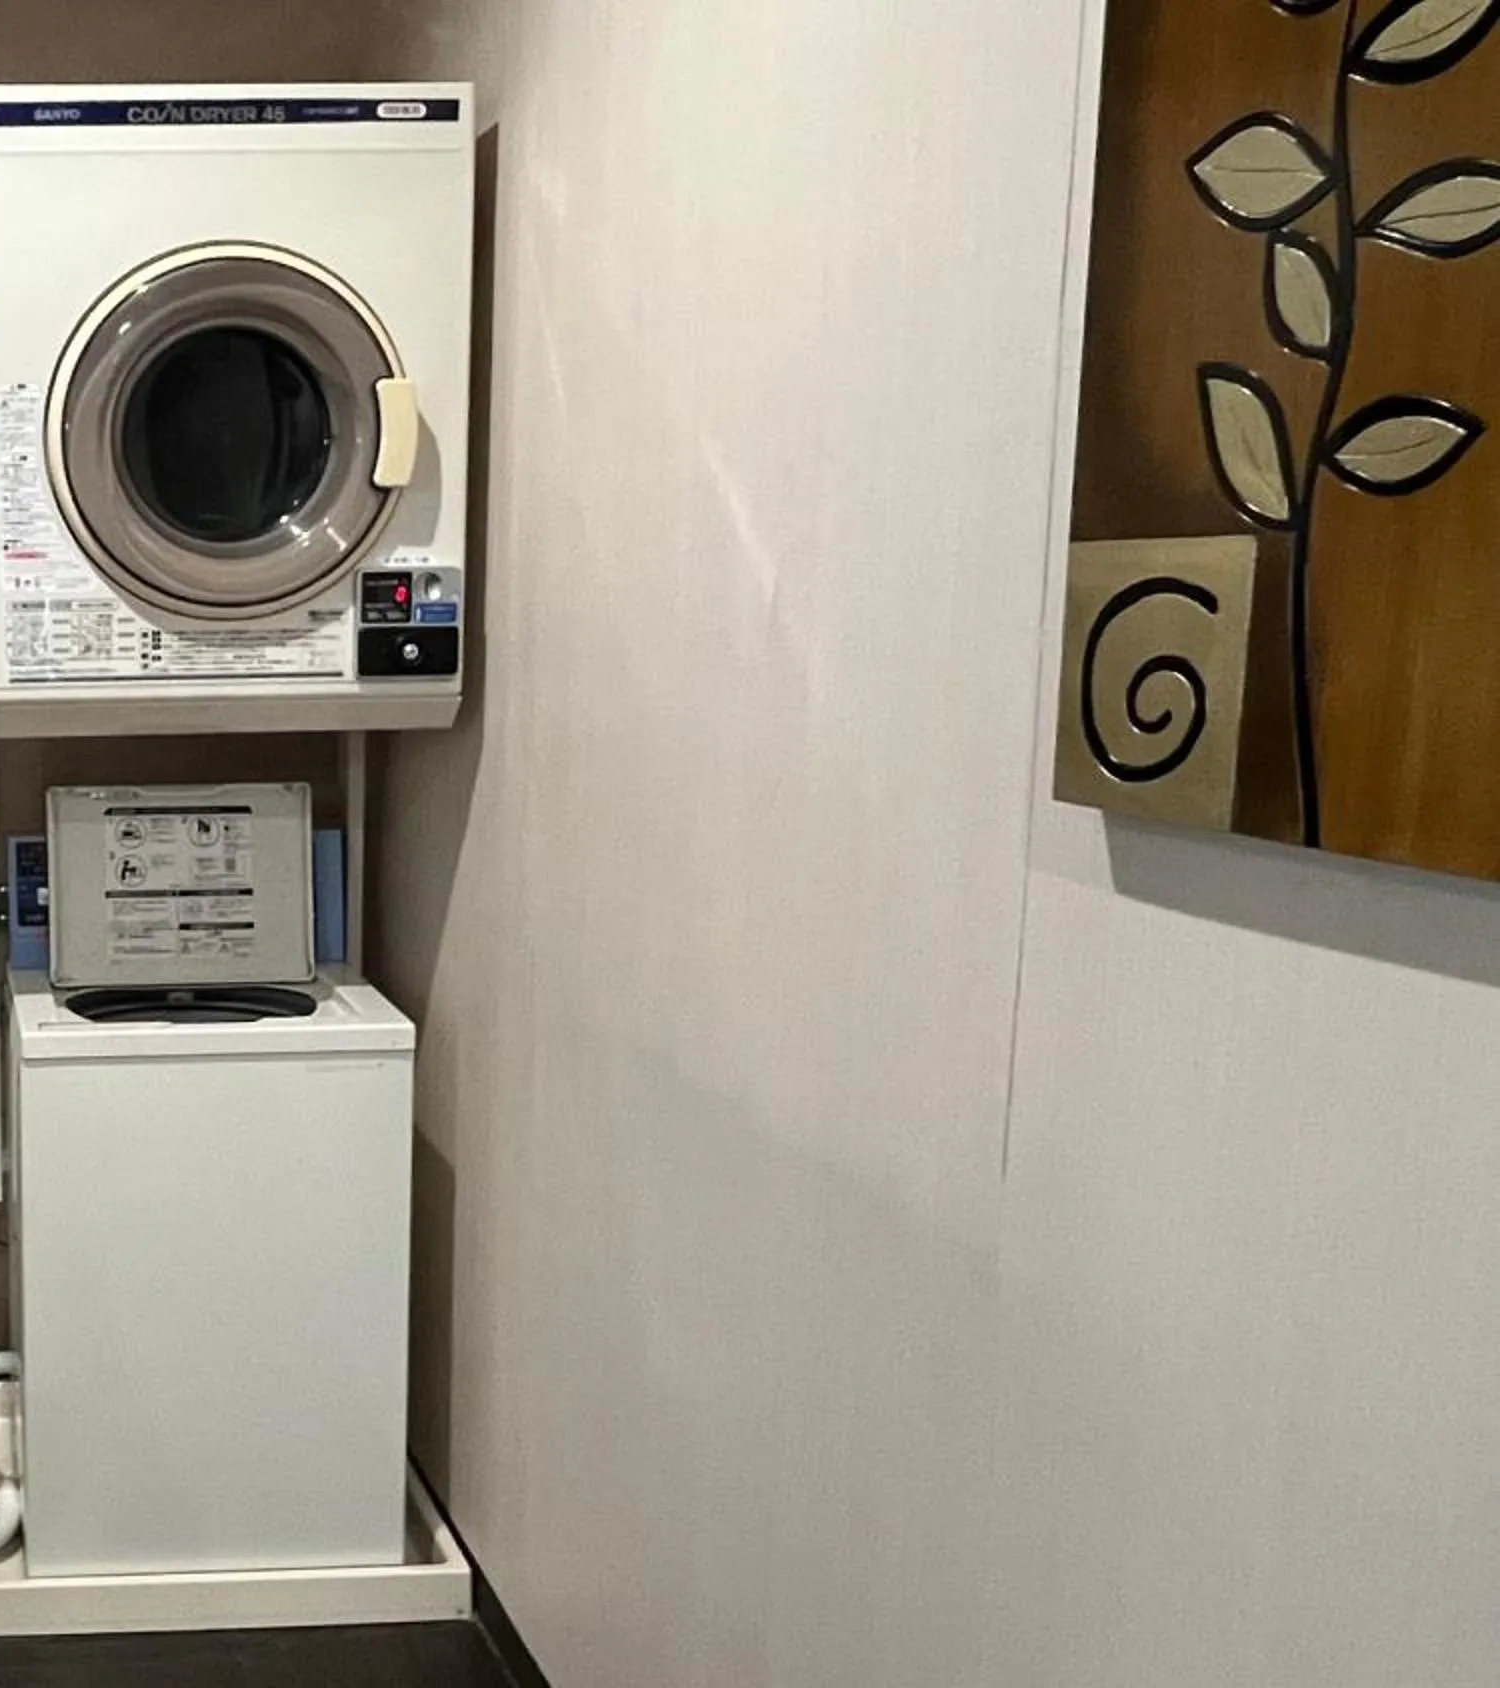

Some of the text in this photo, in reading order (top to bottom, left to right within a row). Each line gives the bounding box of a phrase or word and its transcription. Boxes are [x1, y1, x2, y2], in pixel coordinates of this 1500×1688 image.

[33, 107, 81, 121] SANYO
[190, 106, 256, 122] DRYER
[261, 105, 286, 121] 45
